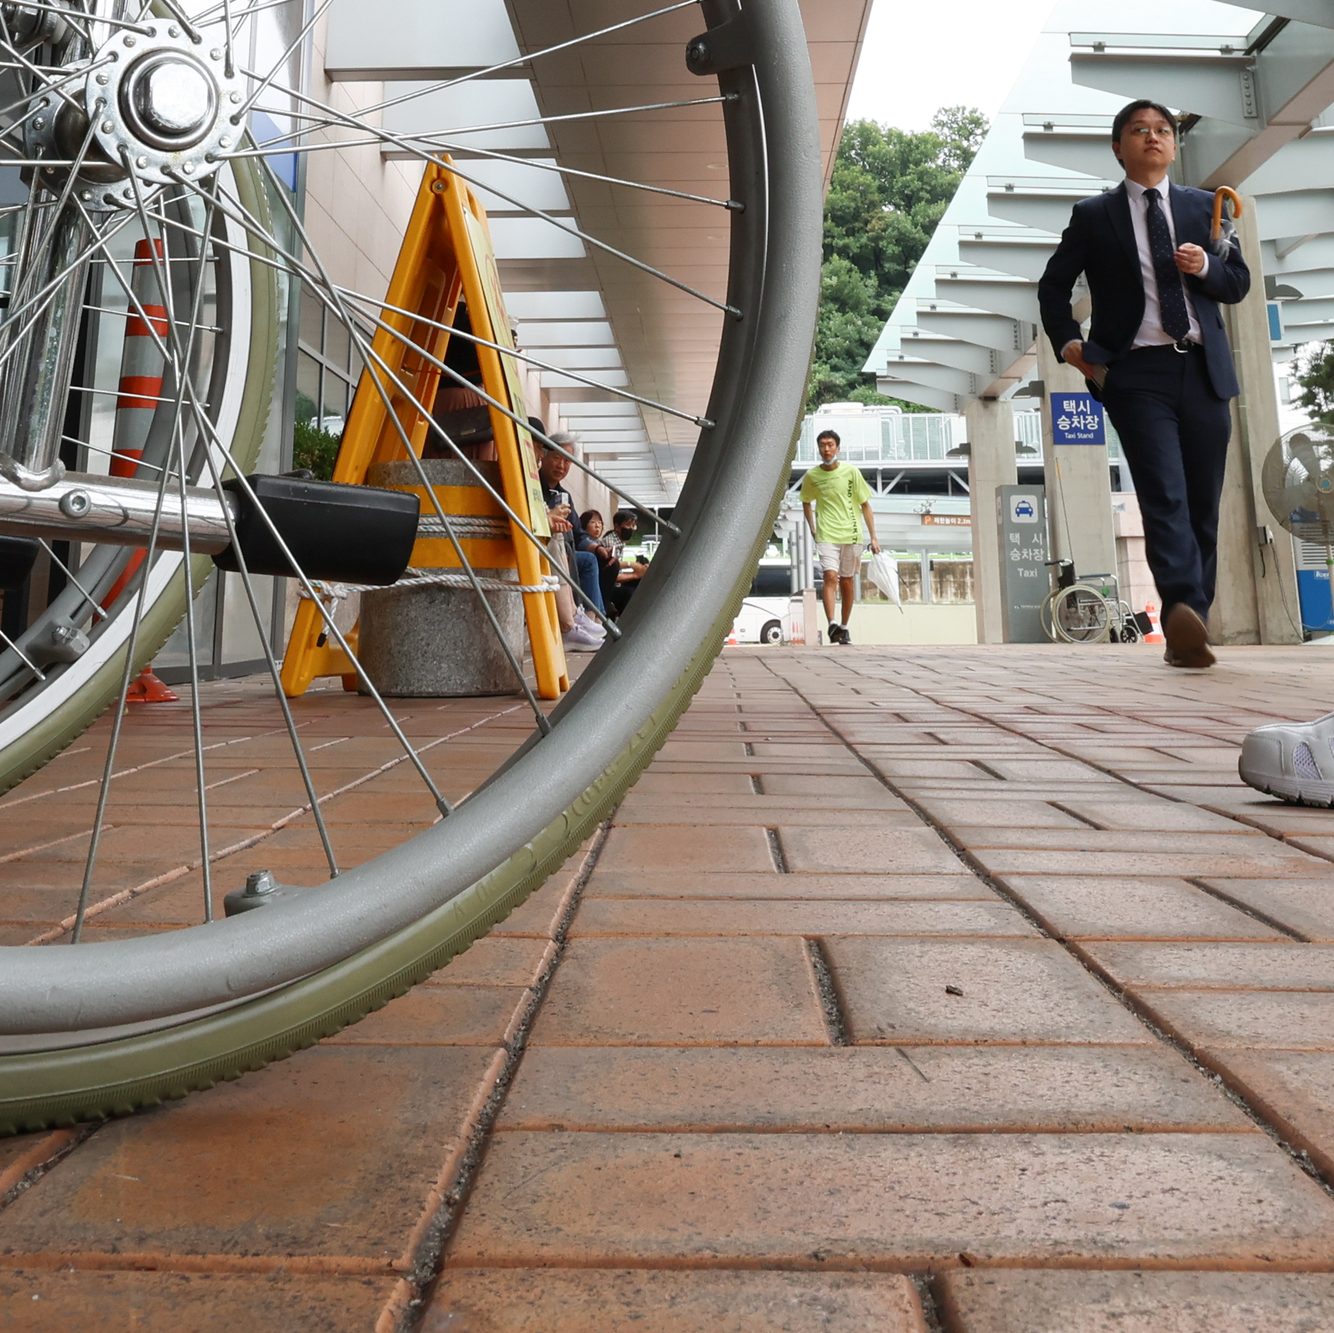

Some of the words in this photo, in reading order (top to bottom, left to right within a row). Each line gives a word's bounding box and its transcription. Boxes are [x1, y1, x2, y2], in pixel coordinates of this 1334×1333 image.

[1063, 399, 1090, 415] 택시
[1057, 415, 1099, 430] 승차장
[1009, 548, 1044, 561] 승차장
[1017, 568, 1038, 578] Taxi
